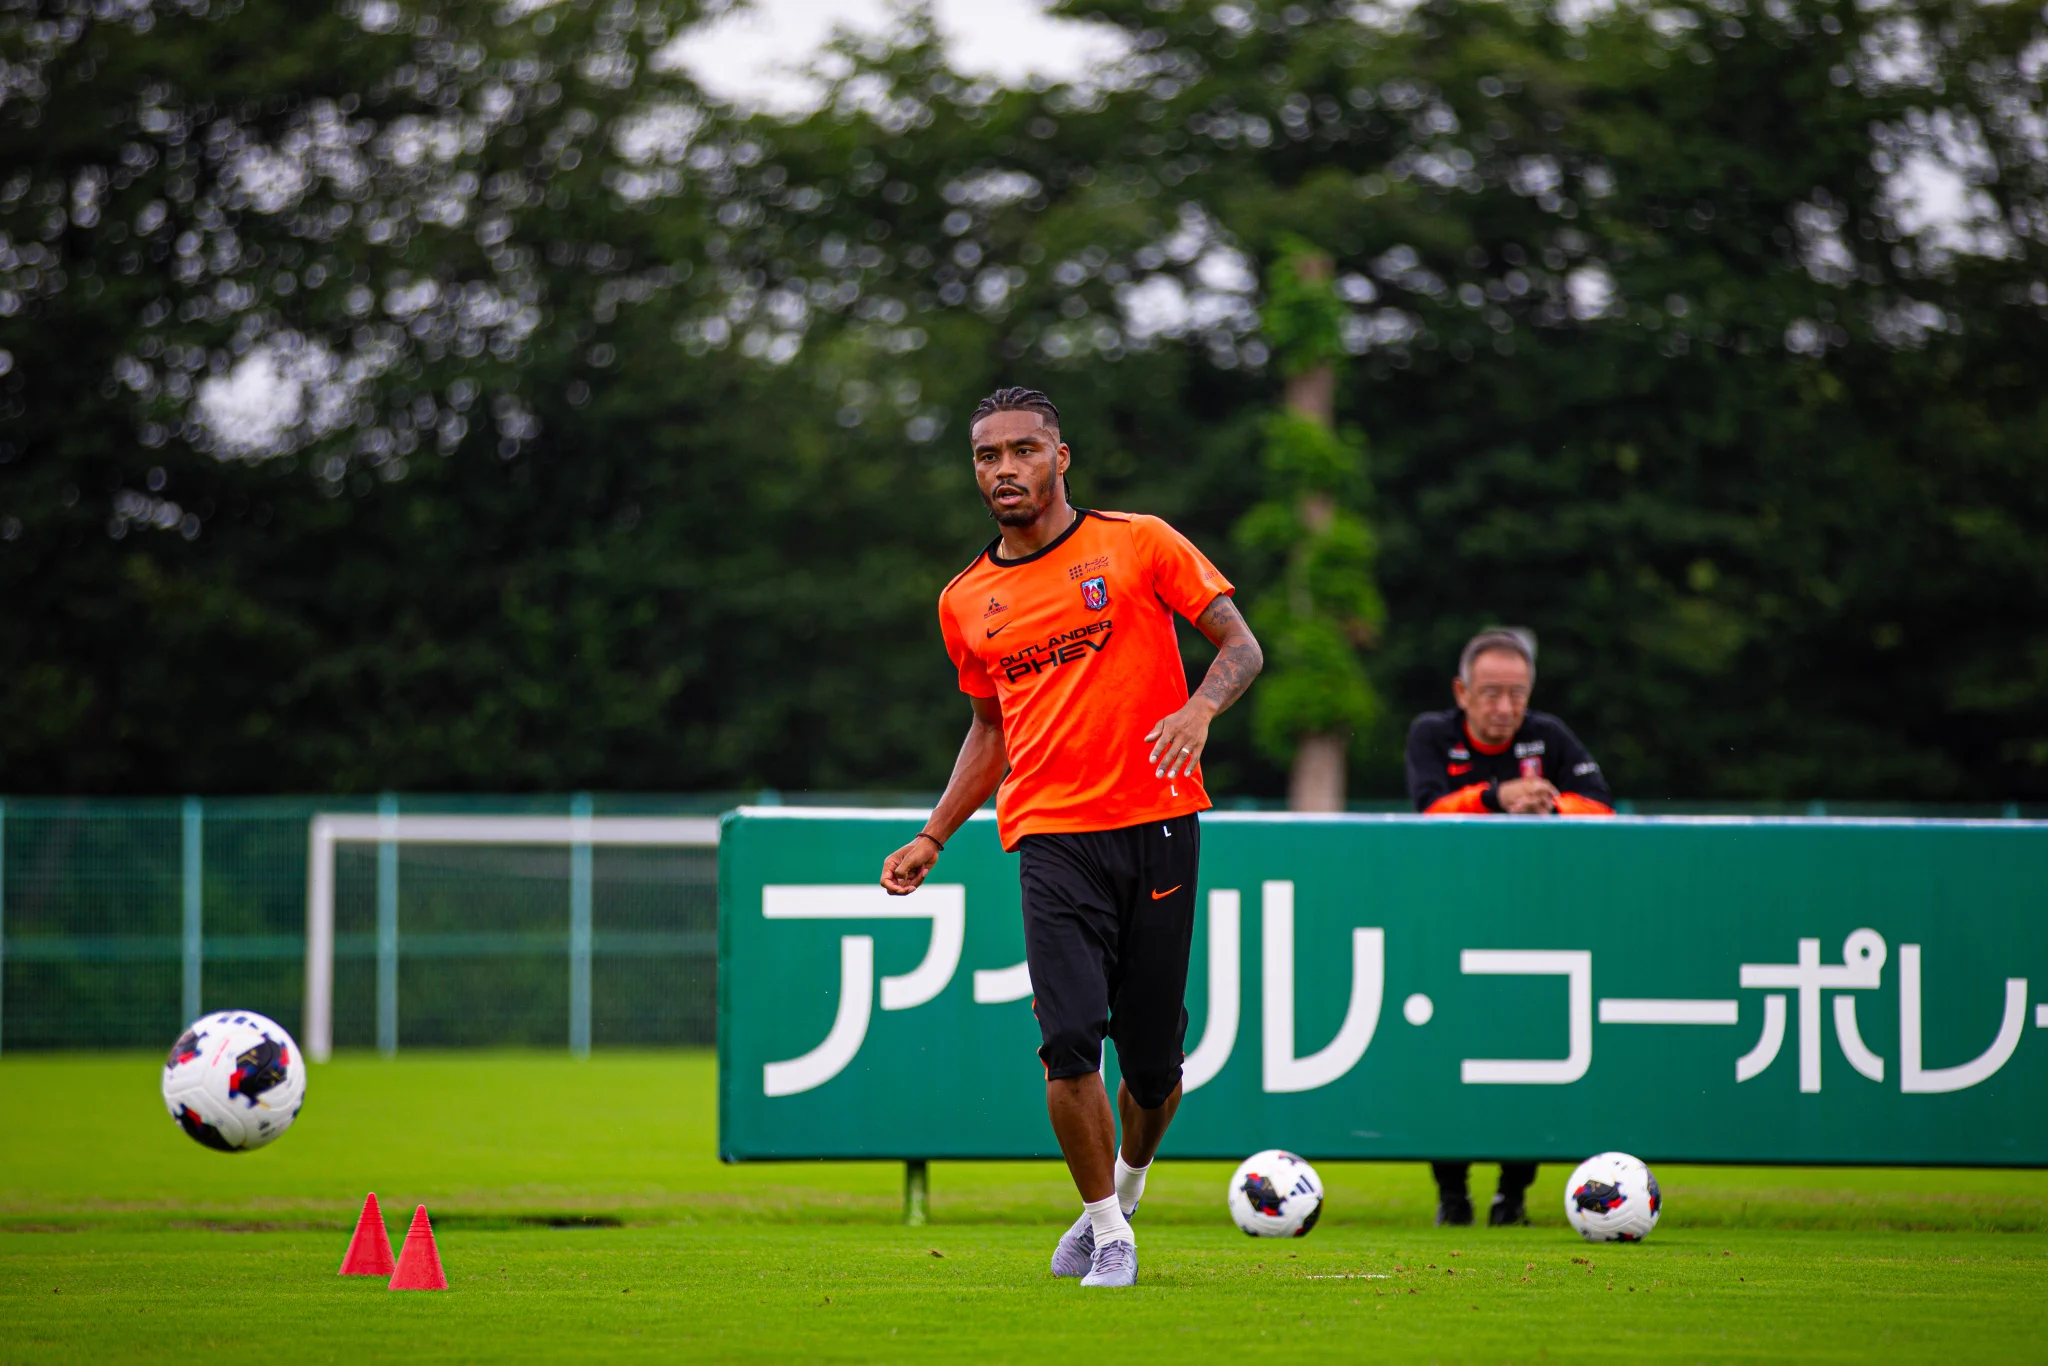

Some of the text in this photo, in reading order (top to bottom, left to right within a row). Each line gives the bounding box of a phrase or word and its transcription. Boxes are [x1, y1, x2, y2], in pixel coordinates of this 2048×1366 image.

[1000, 619, 1113, 667] OUTLANDER
[1005, 630, 1113, 684] PHEV
[1171, 784, 1179, 797] L
[1163, 825, 1172, 838] L
[762, 880, 2048, 1098] アル・コーポレ
